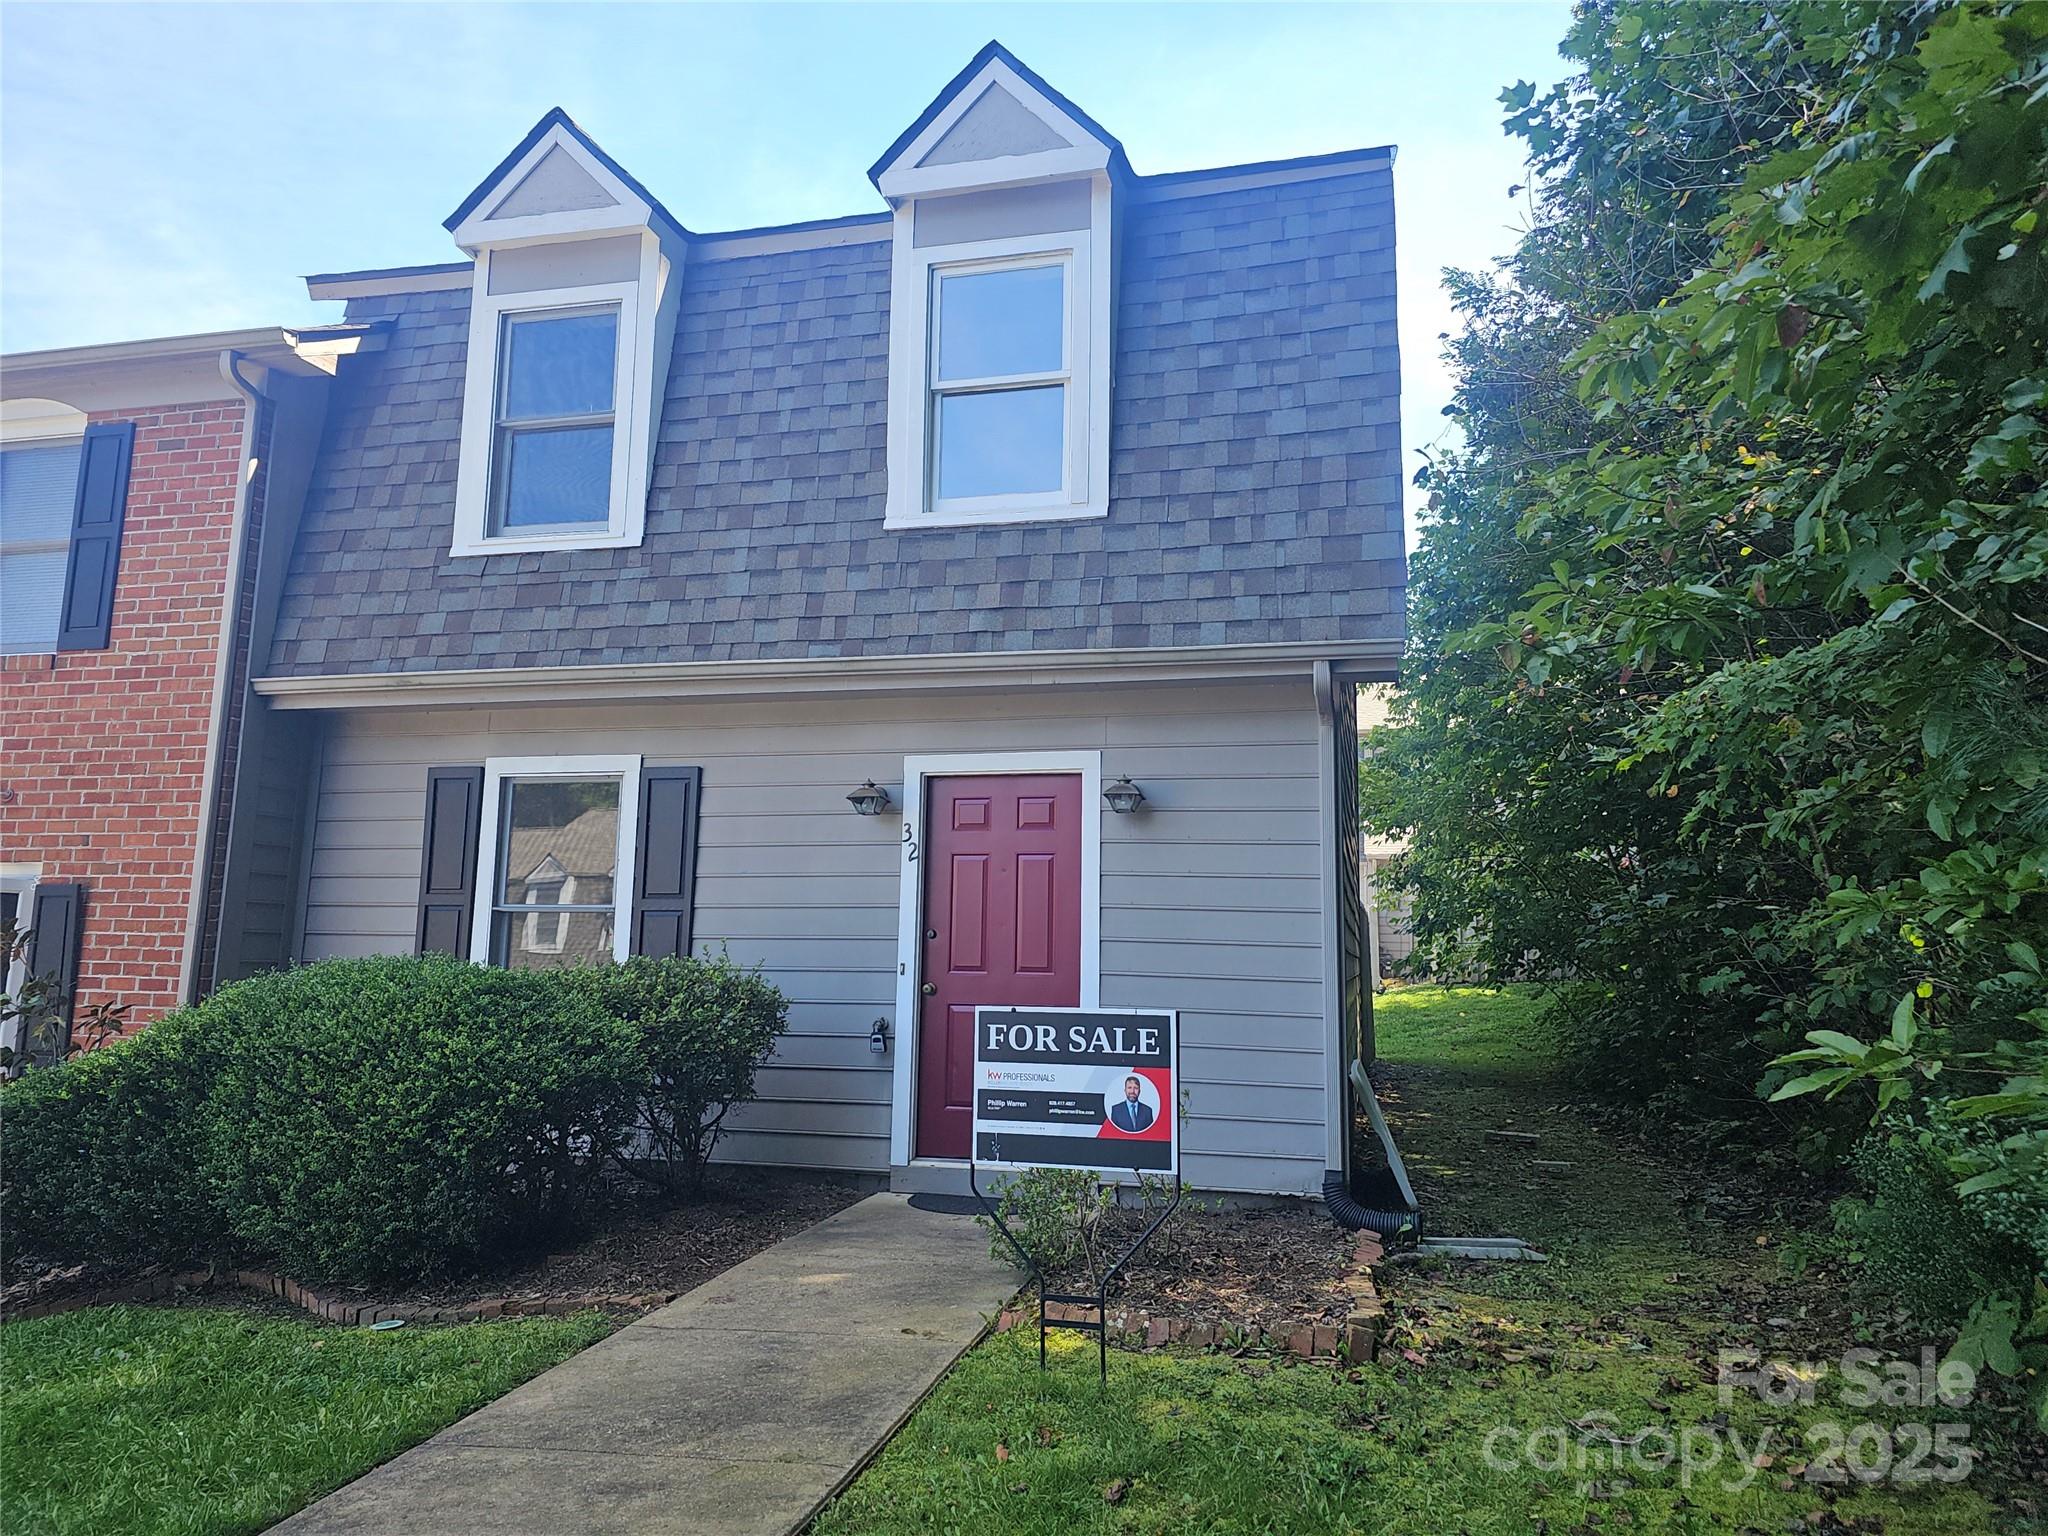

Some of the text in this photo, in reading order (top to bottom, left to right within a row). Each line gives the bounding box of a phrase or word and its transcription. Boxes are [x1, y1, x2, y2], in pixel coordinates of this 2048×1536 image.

[902, 822, 919, 862] 32
[986, 1023, 1160, 1055] FOR SALE
[987, 1068, 1056, 1082] kw PROFESSIONALS
[987, 1099, 1006, 1107] Phillip
